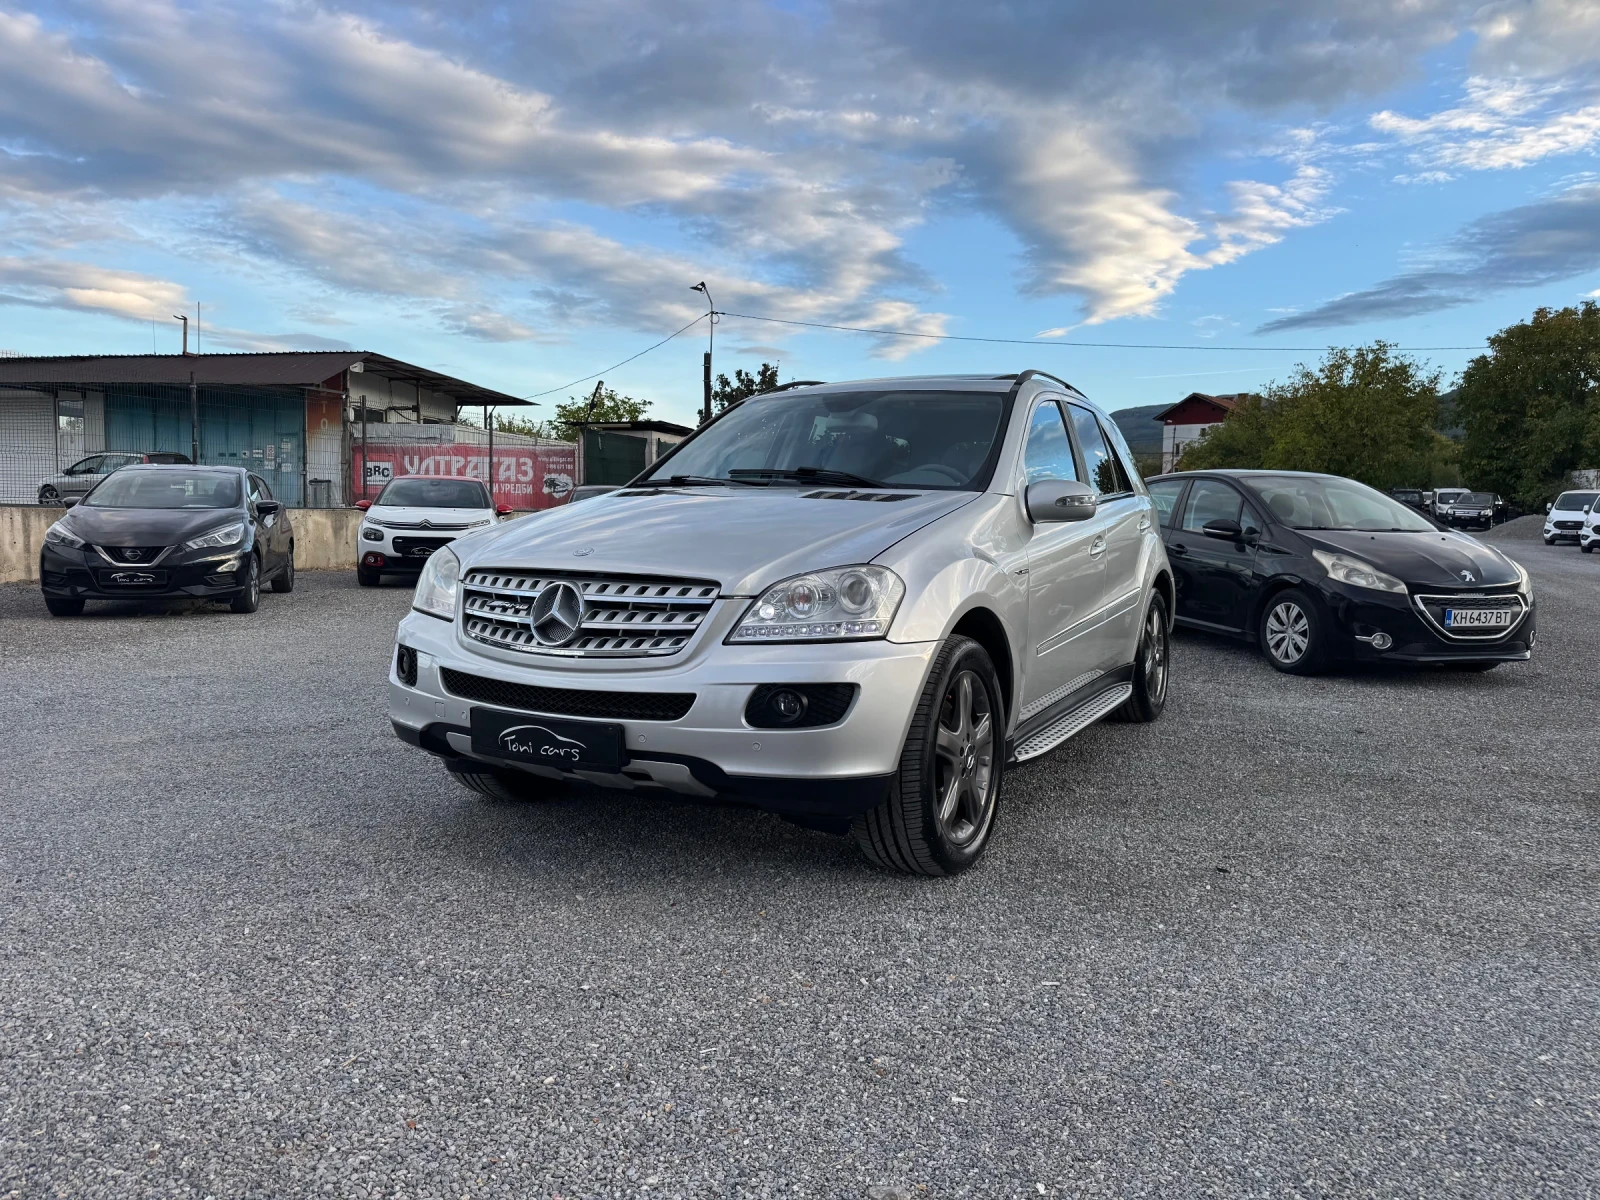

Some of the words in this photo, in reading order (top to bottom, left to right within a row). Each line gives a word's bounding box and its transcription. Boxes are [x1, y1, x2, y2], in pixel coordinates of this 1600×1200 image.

[366, 466, 390, 477] BRC
[404, 455, 533, 481] УЛТРАГАЗ
[500, 483, 533, 495] УРЕДБИ
[504, 735, 533, 754] Toni
[540, 745, 580, 761] cars
